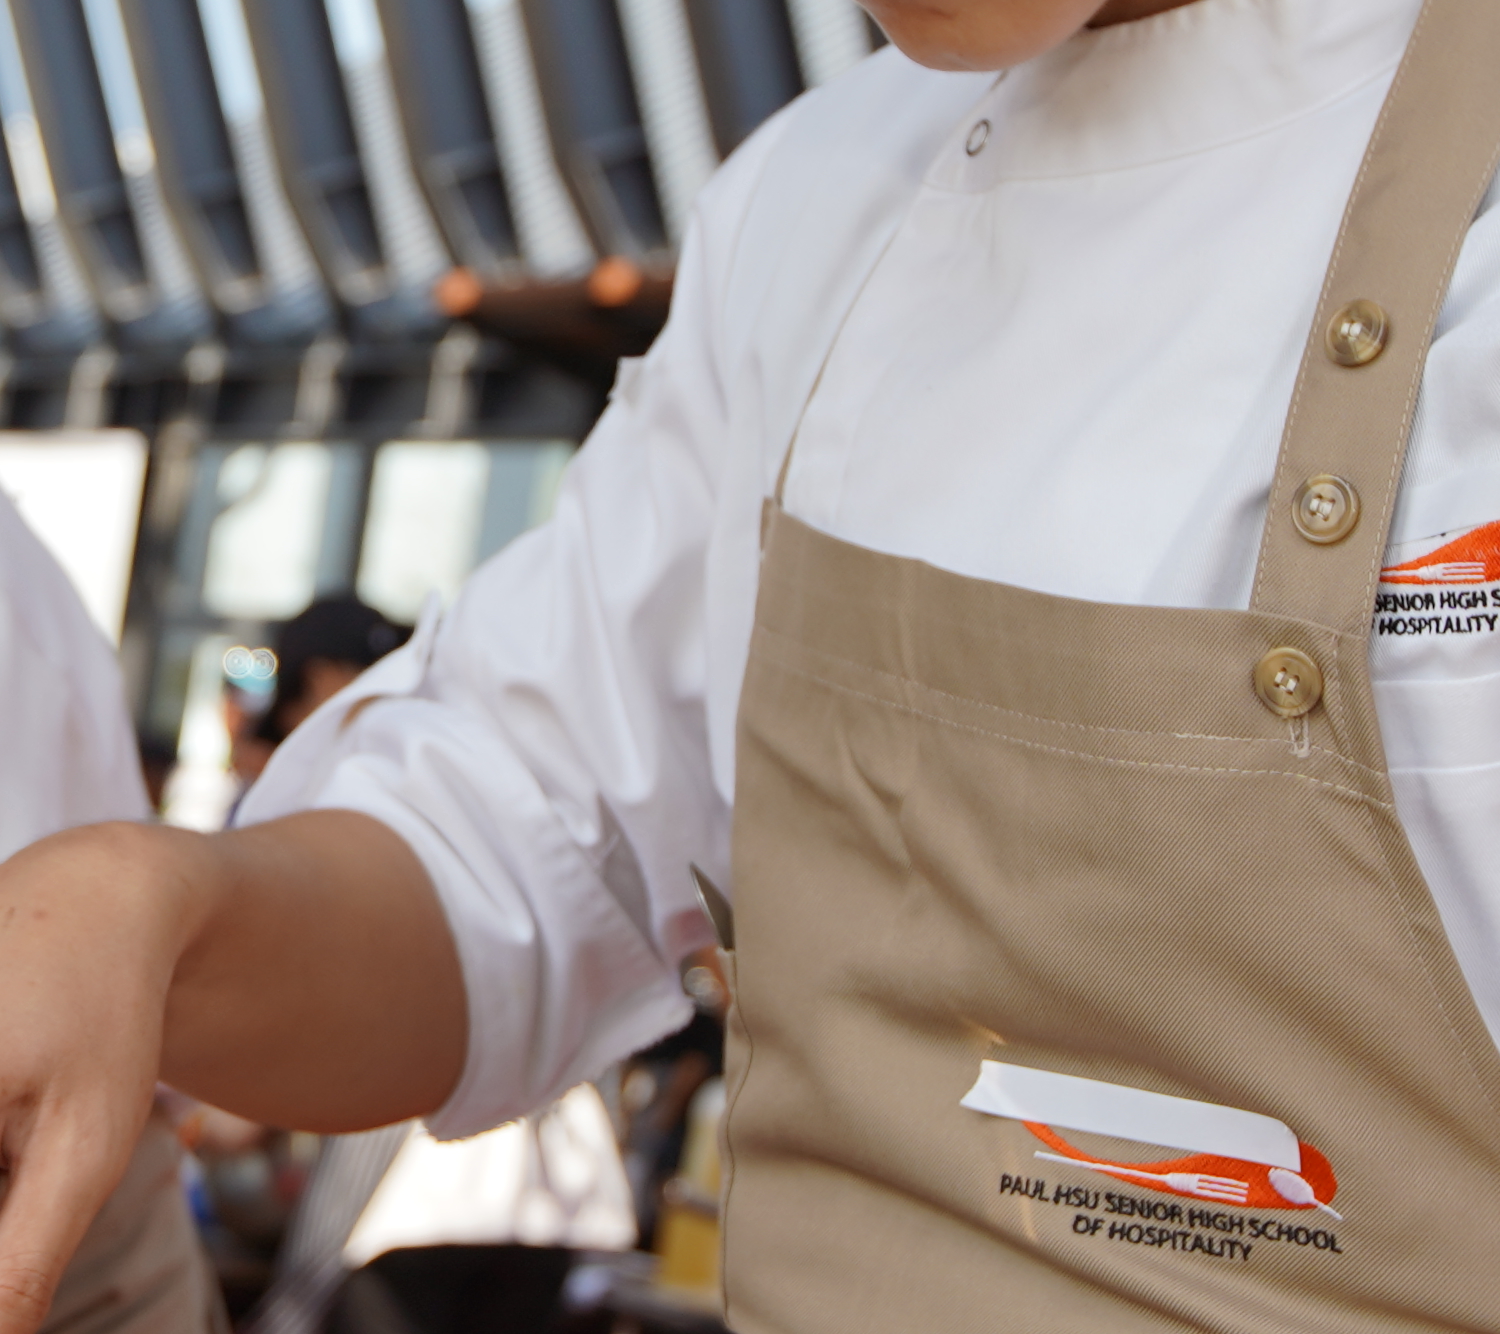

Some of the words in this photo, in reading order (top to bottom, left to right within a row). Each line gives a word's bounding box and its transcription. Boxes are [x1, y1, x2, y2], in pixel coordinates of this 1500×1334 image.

[1439, 589, 1488, 610] HIGH
[1379, 614, 1499, 636] HOSPITALITY
[1000, 1172, 1050, 1203] PAUL
[1052, 1184, 1101, 1210] HSU
[1104, 1191, 1184, 1225] SENIOR
[1188, 1207, 1245, 1234] HIGH
[1249, 1217, 1343, 1255] SCHOOL
[1071, 1214, 1105, 1236] OF
[1107, 1221, 1253, 1262] HOSPITALITY
